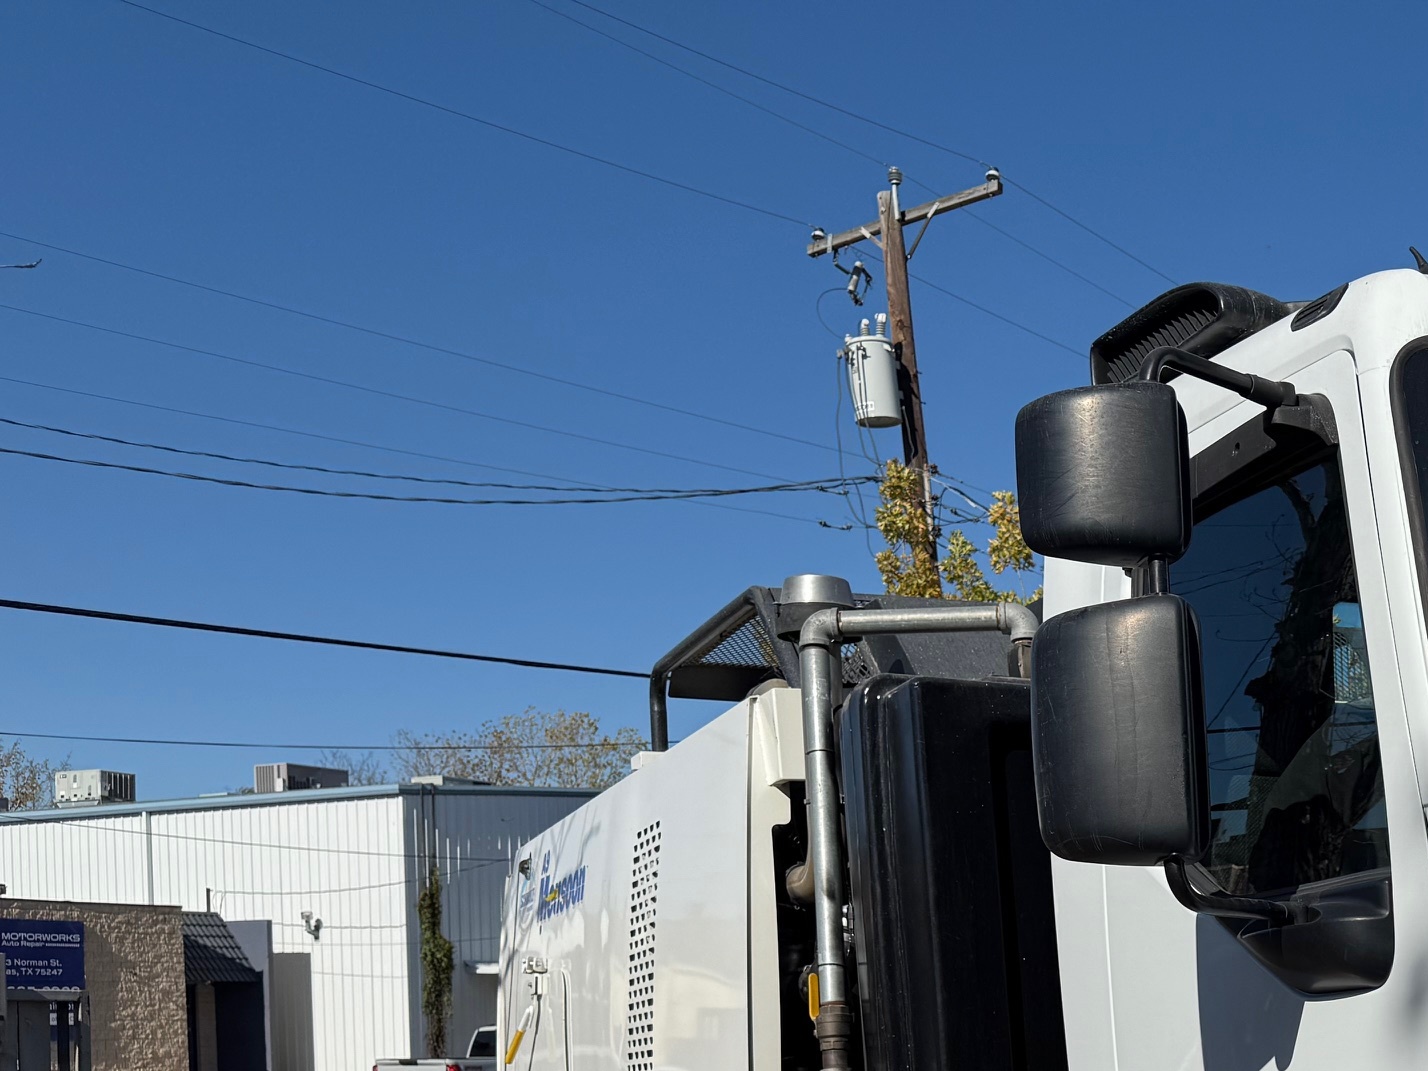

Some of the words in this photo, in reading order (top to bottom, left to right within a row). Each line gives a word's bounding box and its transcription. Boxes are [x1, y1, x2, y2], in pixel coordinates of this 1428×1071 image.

[1, 932, 80, 942] MOTORWORKS
[14, 958, 48, 966] Norman
[50, 959, 62, 967] St.
[5, 969, 19, 977] as,
[20, 968, 33, 976] TX
